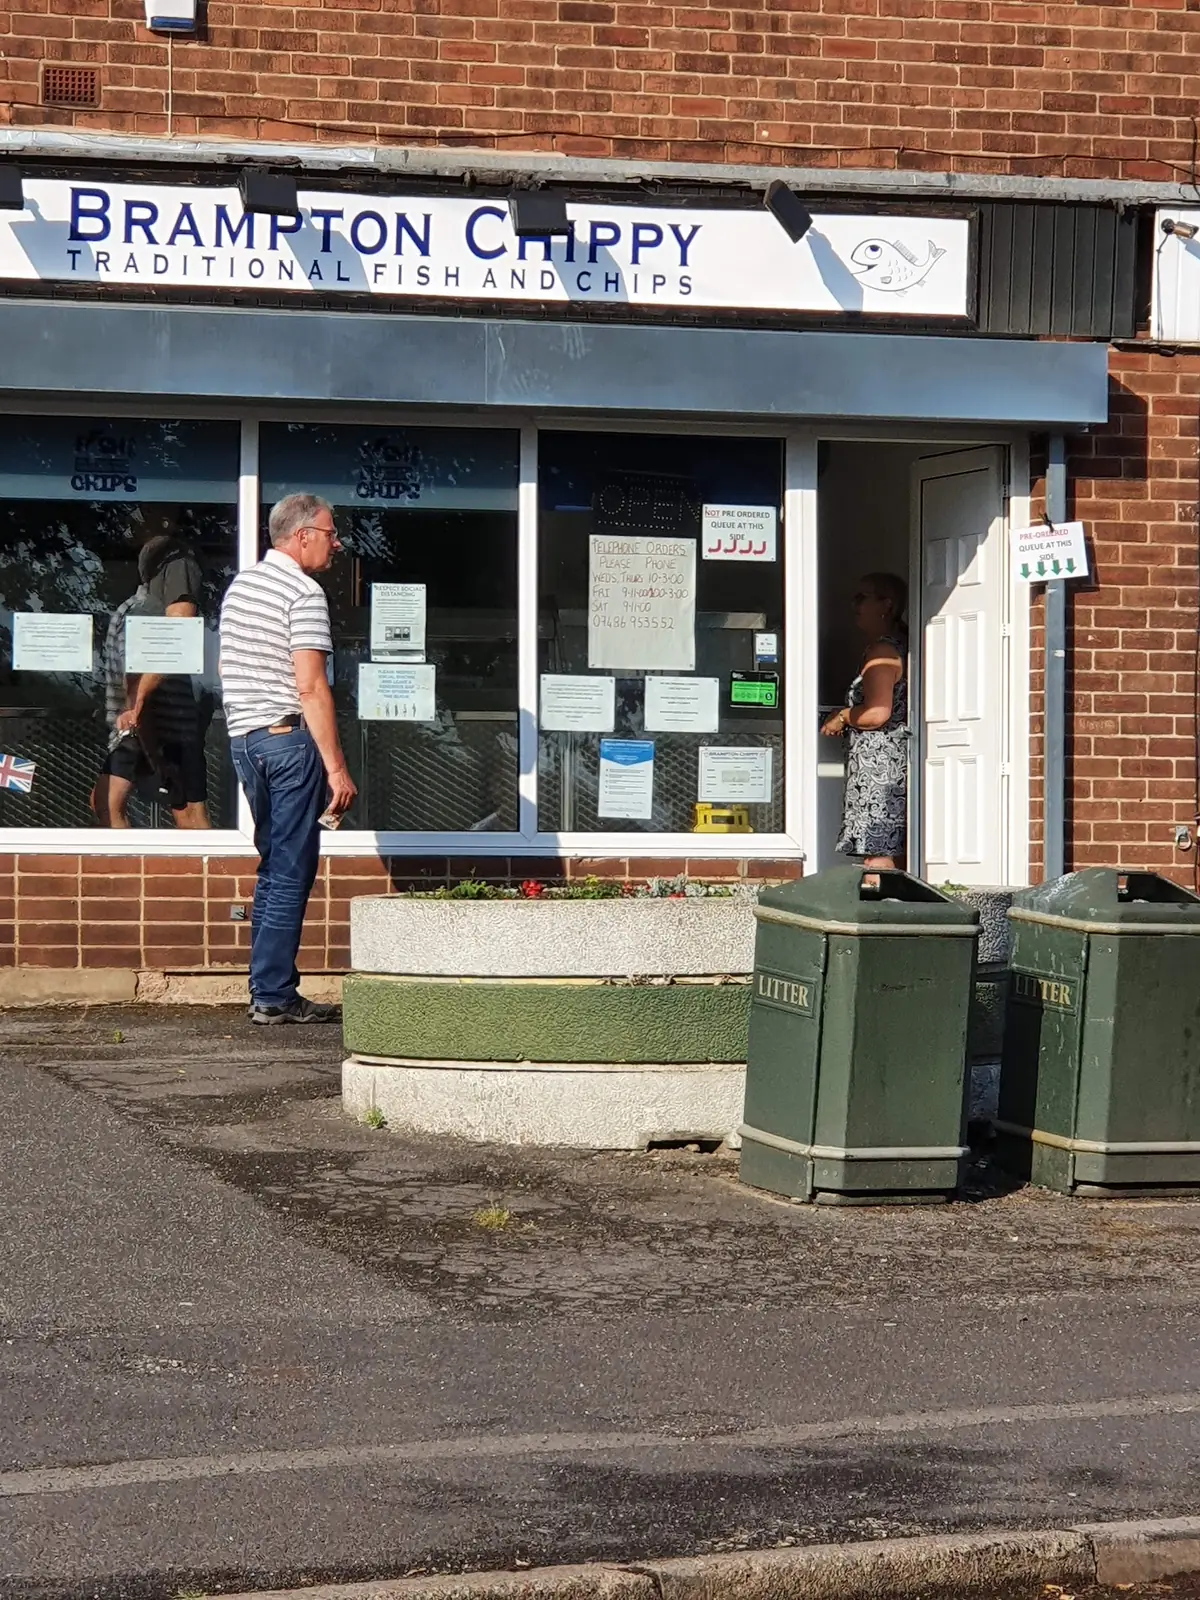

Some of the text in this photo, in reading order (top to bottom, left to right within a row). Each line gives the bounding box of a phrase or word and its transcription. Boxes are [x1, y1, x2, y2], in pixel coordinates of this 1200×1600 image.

[67, 187, 703, 266] BRAMPTON CHIPPY
[67, 249, 693, 295] TRADITIONAL FISH AND CHIPS
[71, 475, 138, 493] CHIPS
[705, 510, 721, 518] NOT
[722, 510, 735, 518] PRE
[711, 521, 735, 529] QUEUE
[1019, 528, 1069, 541] PRE-ORDERED
[592, 539, 686, 556] TELEPHONE ORDERS
[1018, 540, 1072, 552] QUEUE AT THIS
[600, 556, 677, 569] PLEASE PHONE
[1039, 553, 1055, 561] SIDE
[592, 584, 610, 598] FRI
[592, 600, 609, 612] SAT
[592, 614, 675, 630] 07486 953552
[758, 975, 810, 1008] LITTER
[1015, 974, 1072, 1006] LITTER
